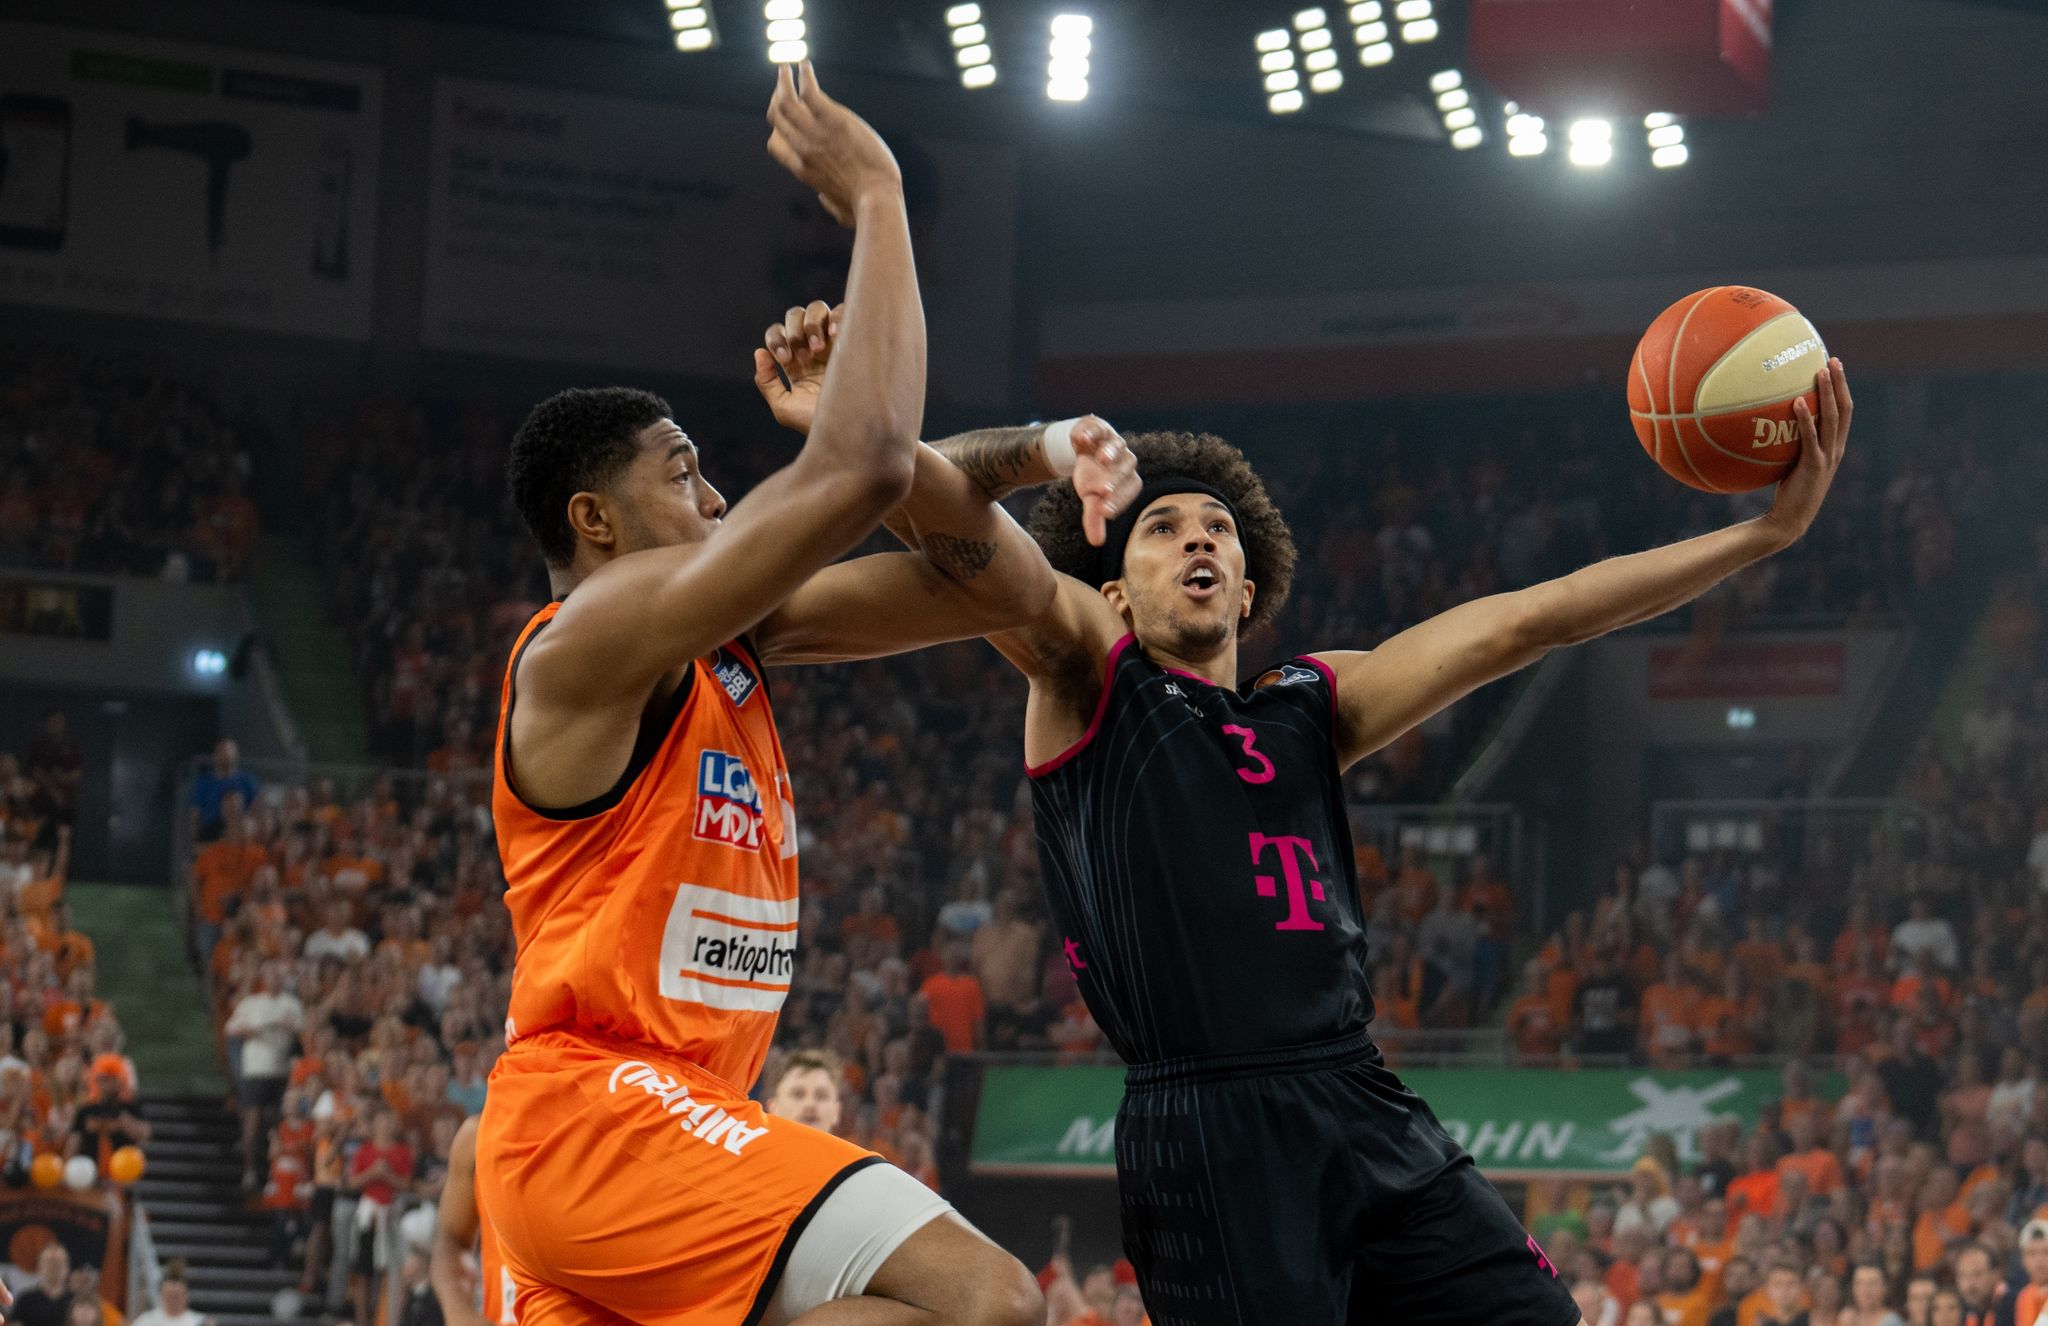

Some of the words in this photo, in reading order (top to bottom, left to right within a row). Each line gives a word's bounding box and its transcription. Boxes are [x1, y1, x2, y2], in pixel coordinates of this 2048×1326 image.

[726, 671, 752, 701] BBL
[1221, 724, 1276, 785] 3
[1248, 832, 1326, 931] T
